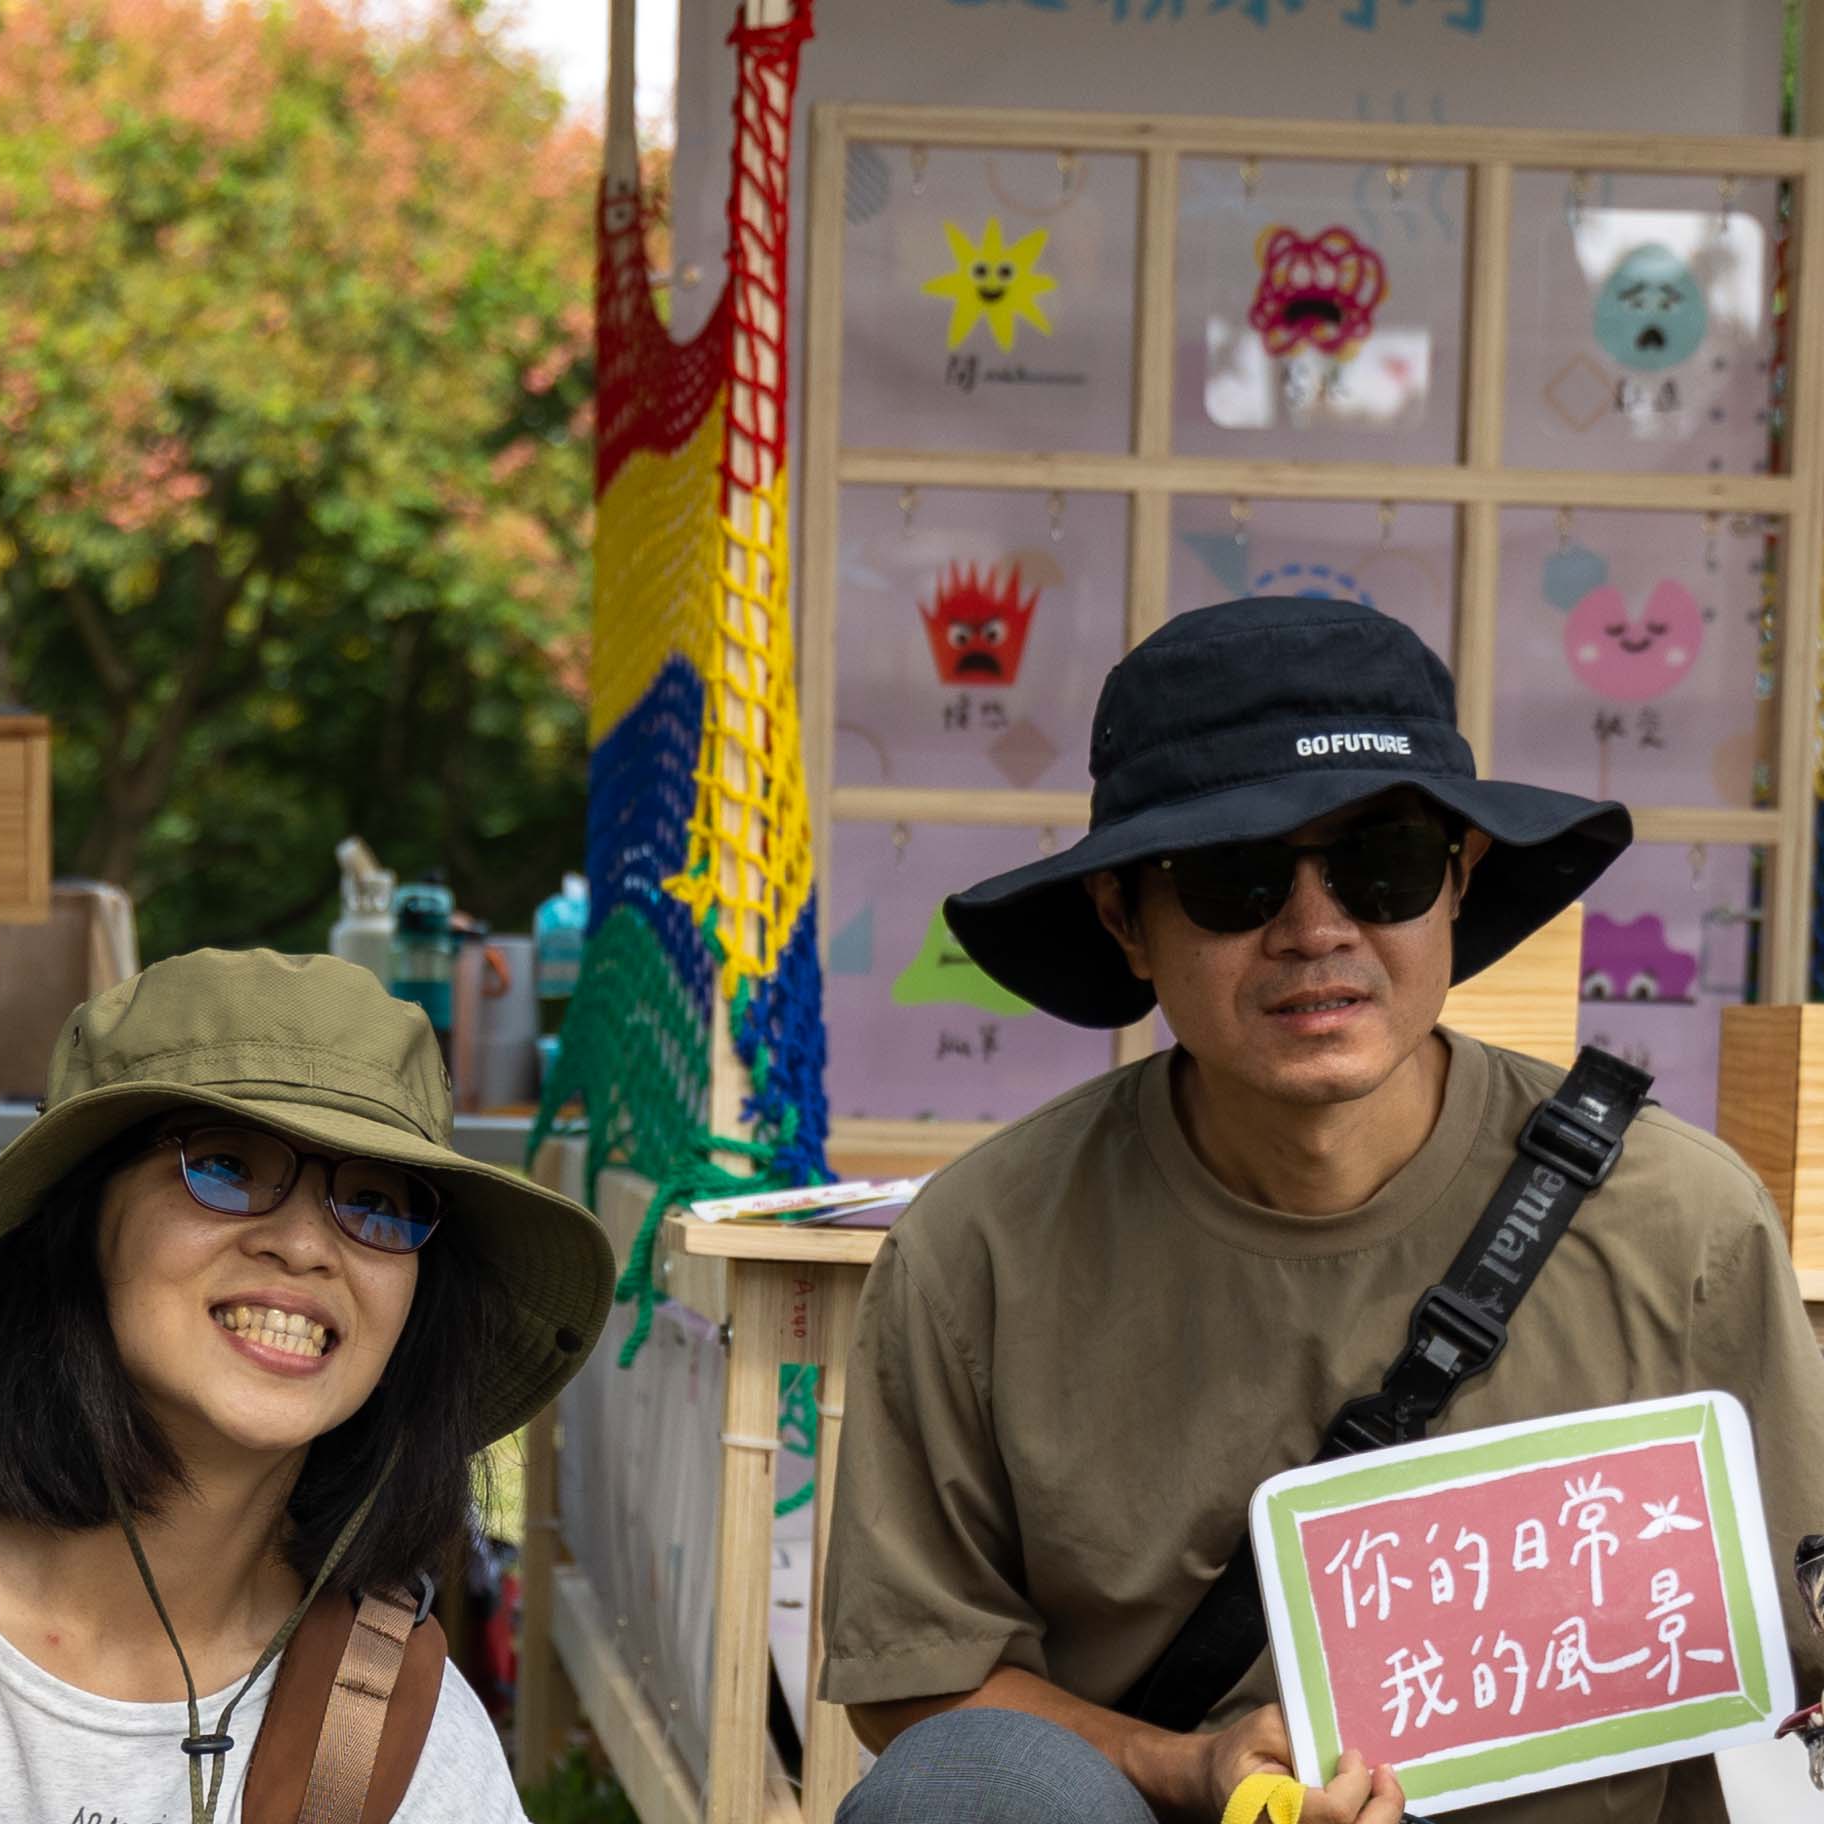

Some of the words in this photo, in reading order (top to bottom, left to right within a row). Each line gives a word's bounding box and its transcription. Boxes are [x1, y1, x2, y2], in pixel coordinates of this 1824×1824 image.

[1479, 1164, 1566, 1285] ental
[1325, 1471, 1624, 1629] 你的日常
[1380, 1567, 1725, 1738] 我的風景
